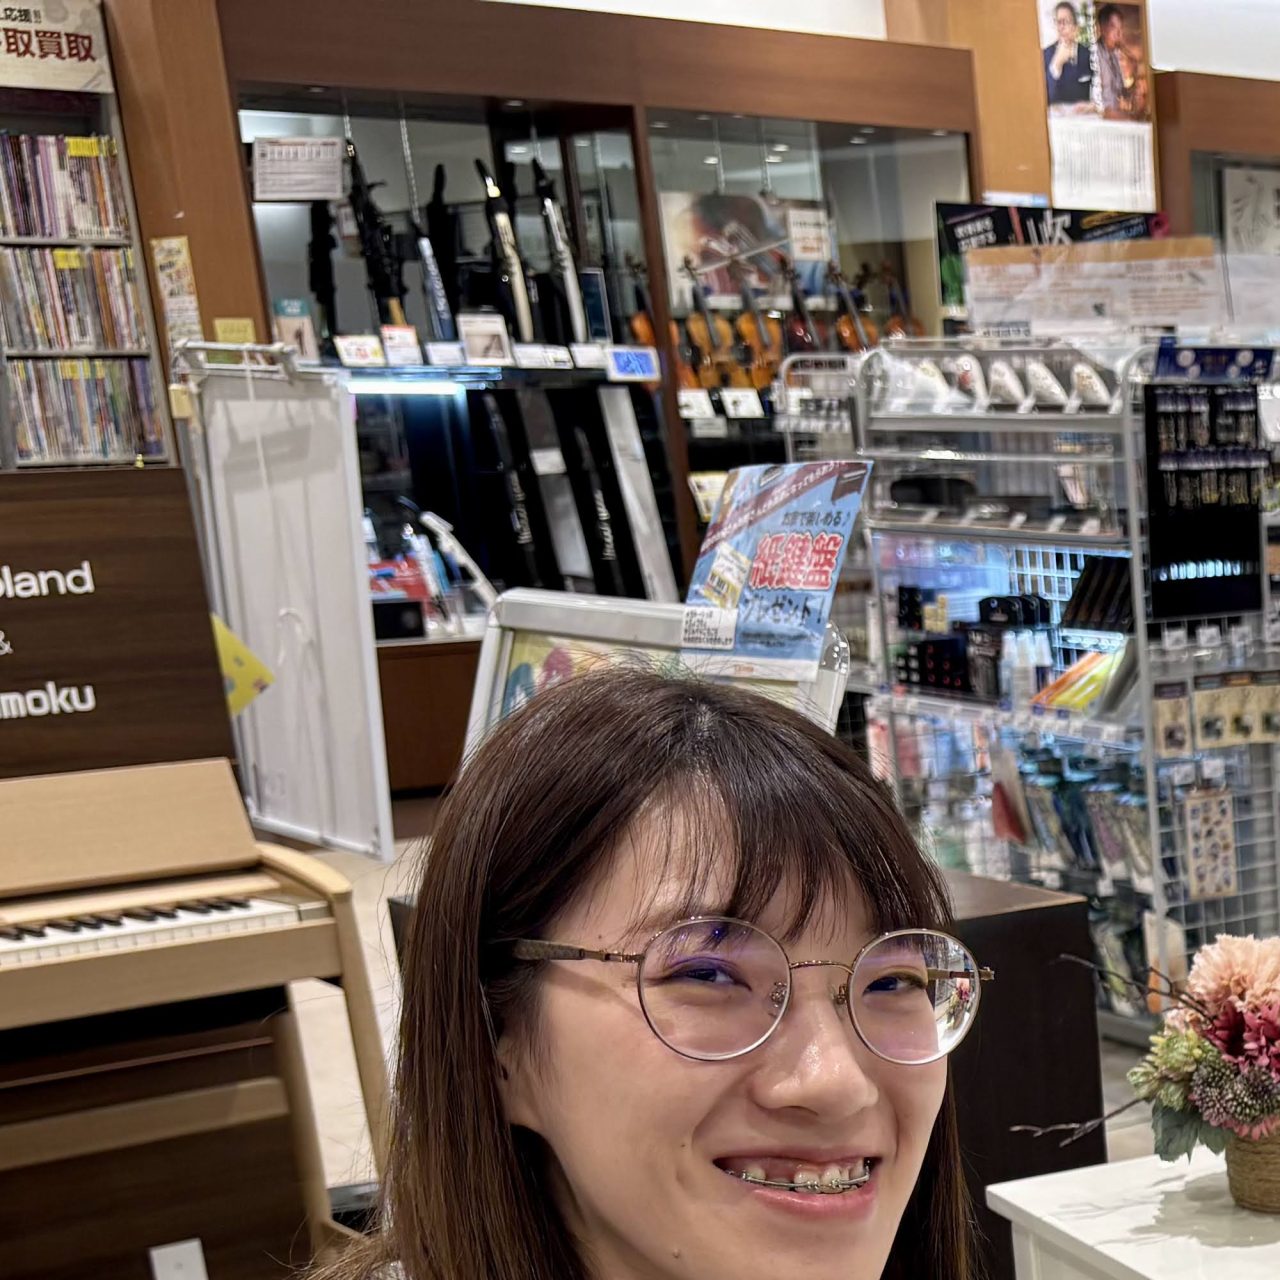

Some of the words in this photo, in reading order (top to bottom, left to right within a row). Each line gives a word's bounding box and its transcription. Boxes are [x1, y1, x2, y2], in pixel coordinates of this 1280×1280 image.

[0, 27, 96, 62] 取買取
[0, 560, 95, 599] land
